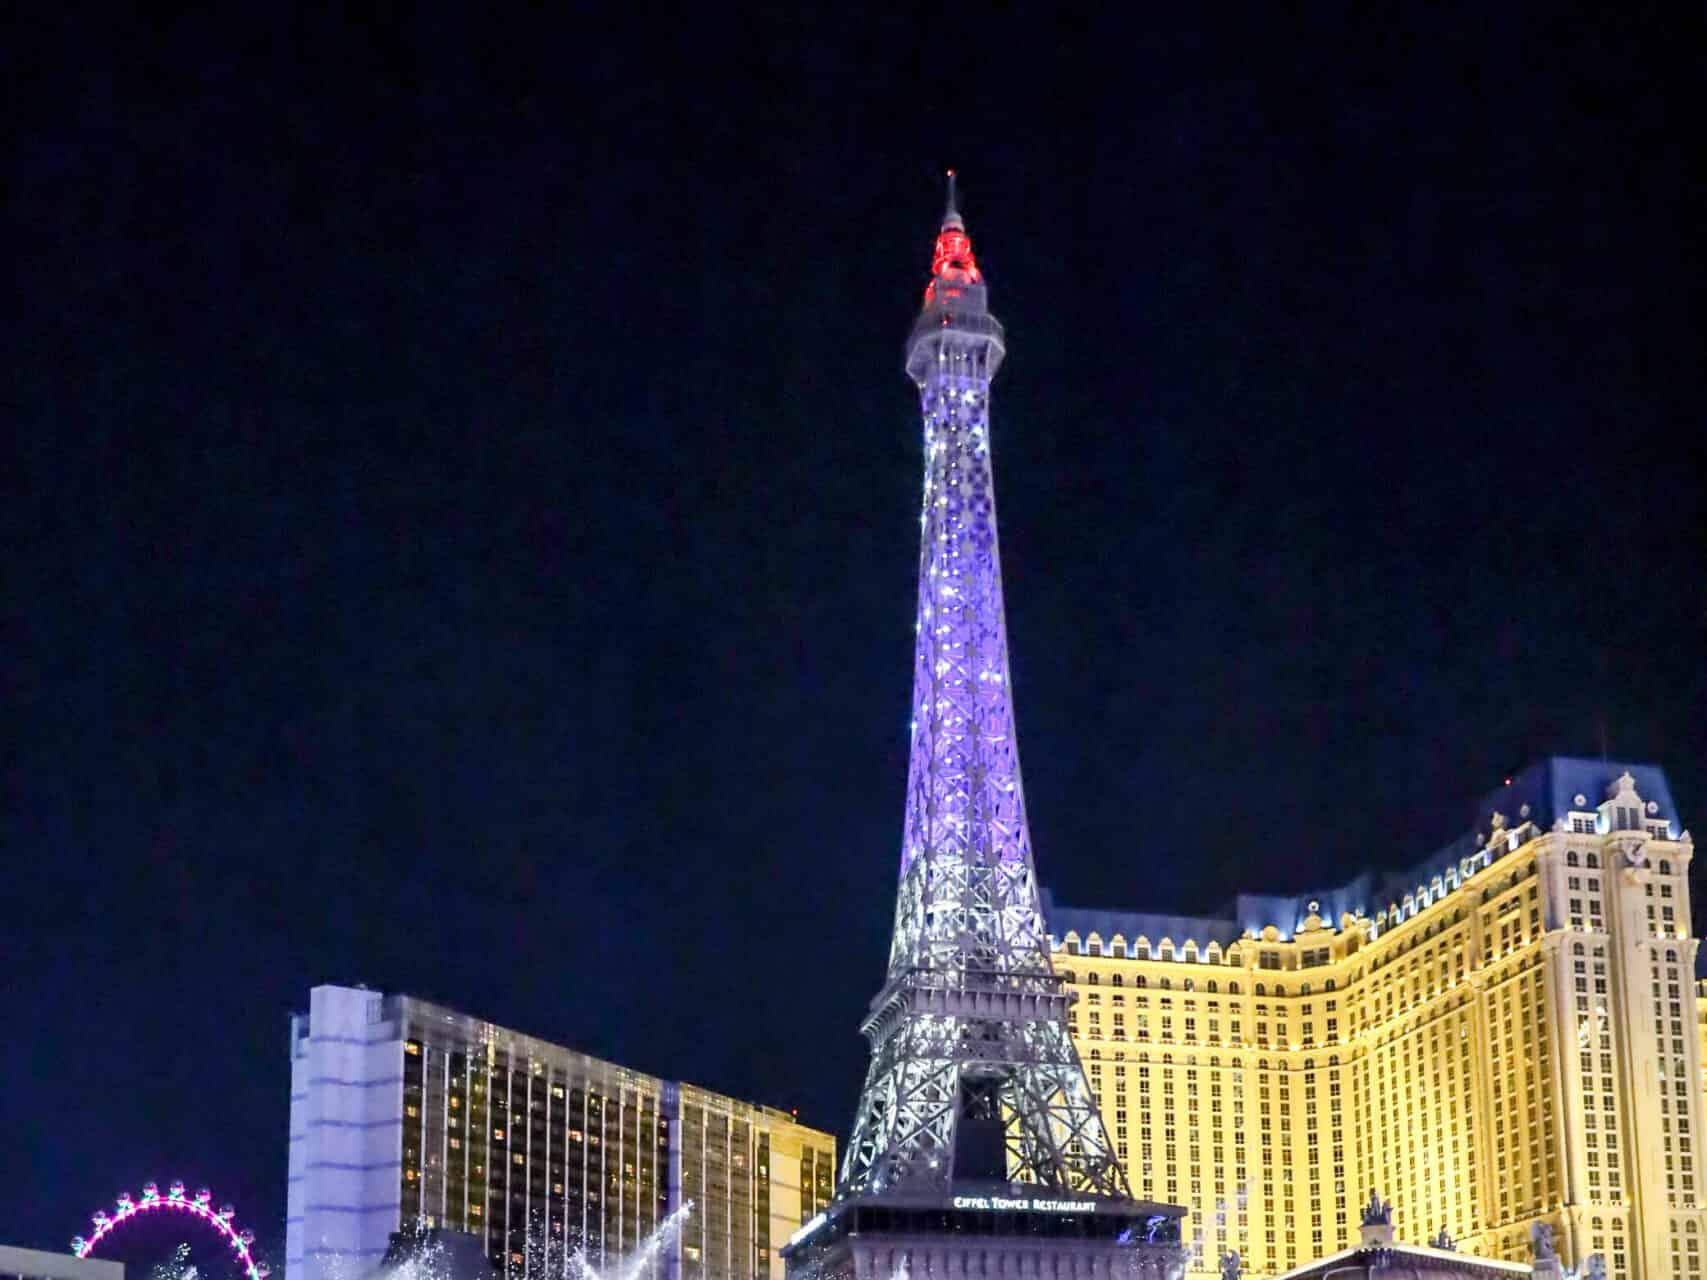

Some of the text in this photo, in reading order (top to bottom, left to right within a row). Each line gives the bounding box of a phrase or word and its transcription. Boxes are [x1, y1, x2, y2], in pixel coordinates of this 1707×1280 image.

[954, 1197, 1096, 1211] EIFFEL TOWER RESTAURANT
